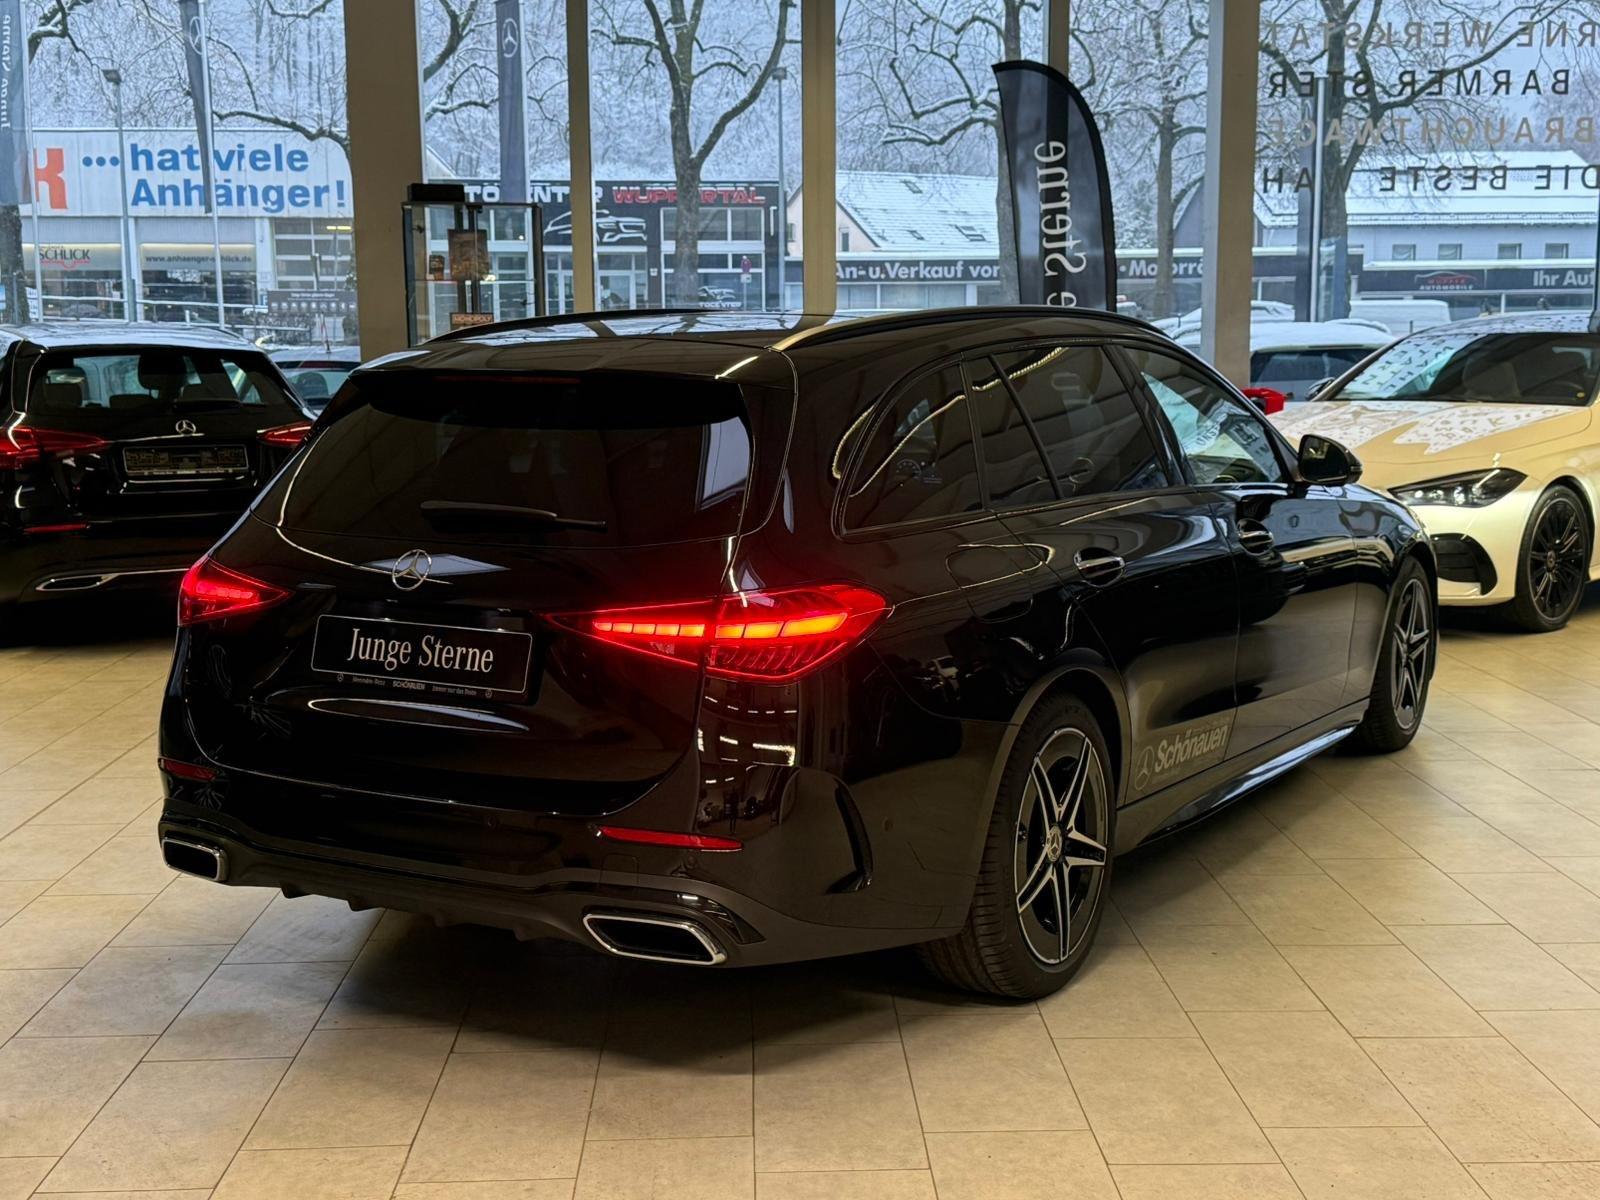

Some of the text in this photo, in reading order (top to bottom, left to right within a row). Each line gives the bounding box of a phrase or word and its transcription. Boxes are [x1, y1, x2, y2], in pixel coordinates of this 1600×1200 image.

[130, 143, 200, 171] hat
[213, 143, 309, 172] viele
[131, 178, 345, 213] Anhänger!
[612, 186, 766, 204] WUPPRTAL
[39, 248, 91, 260] SCHLICK
[145, 254, 252, 265] www.anhaenger-shlick.de
[1533, 270, 1560, 286] Ihr
[347, 627, 494, 673] Junge Sterne
